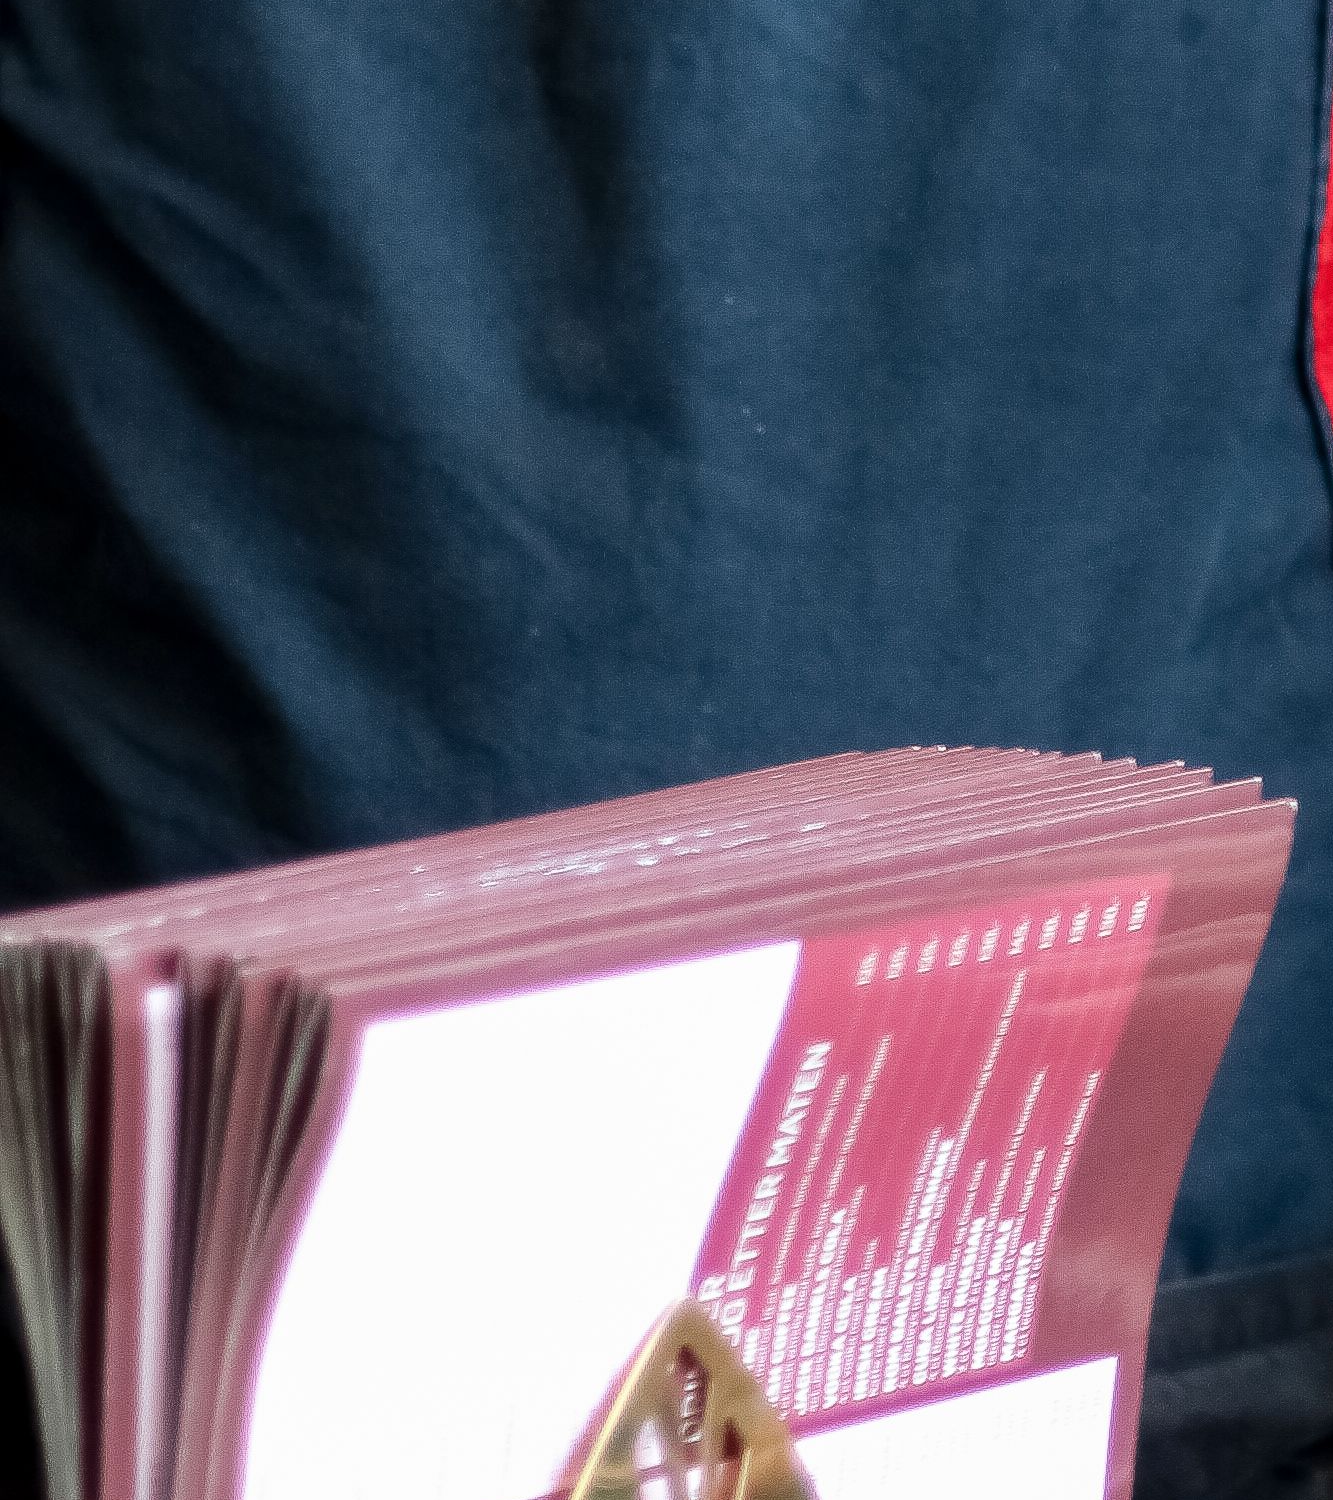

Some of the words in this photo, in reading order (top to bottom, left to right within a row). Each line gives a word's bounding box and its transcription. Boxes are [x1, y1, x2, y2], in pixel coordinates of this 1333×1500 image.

[728, 1171, 786, 1292] ETTER
[766, 1039, 833, 1168] MATEN
[817, 1207, 847, 1265] COLA
[887, 1254, 920, 1344] BAILEYS
[907, 1136, 956, 1255] MILKSHAKE
[796, 1264, 830, 1358] DANIELS
[832, 1274, 859, 1334] COLA
[859, 1265, 889, 1343] CREAM
[920, 1262, 947, 1326] LIBRE
[940, 1309, 964, 1378] WHITE
[952, 1215, 988, 1308] RUSSIAN
[969, 1276, 999, 1370] MOSCOW
[987, 1216, 1014, 1275] MULE
[999, 1240, 1036, 1363] MARGARITA
[787, 1359, 809, 1419] JACK
[820, 1334, 845, 1409] VODKA
[850, 1342, 872, 1401] IRISH
[911, 1326, 933, 1385] CUBA
